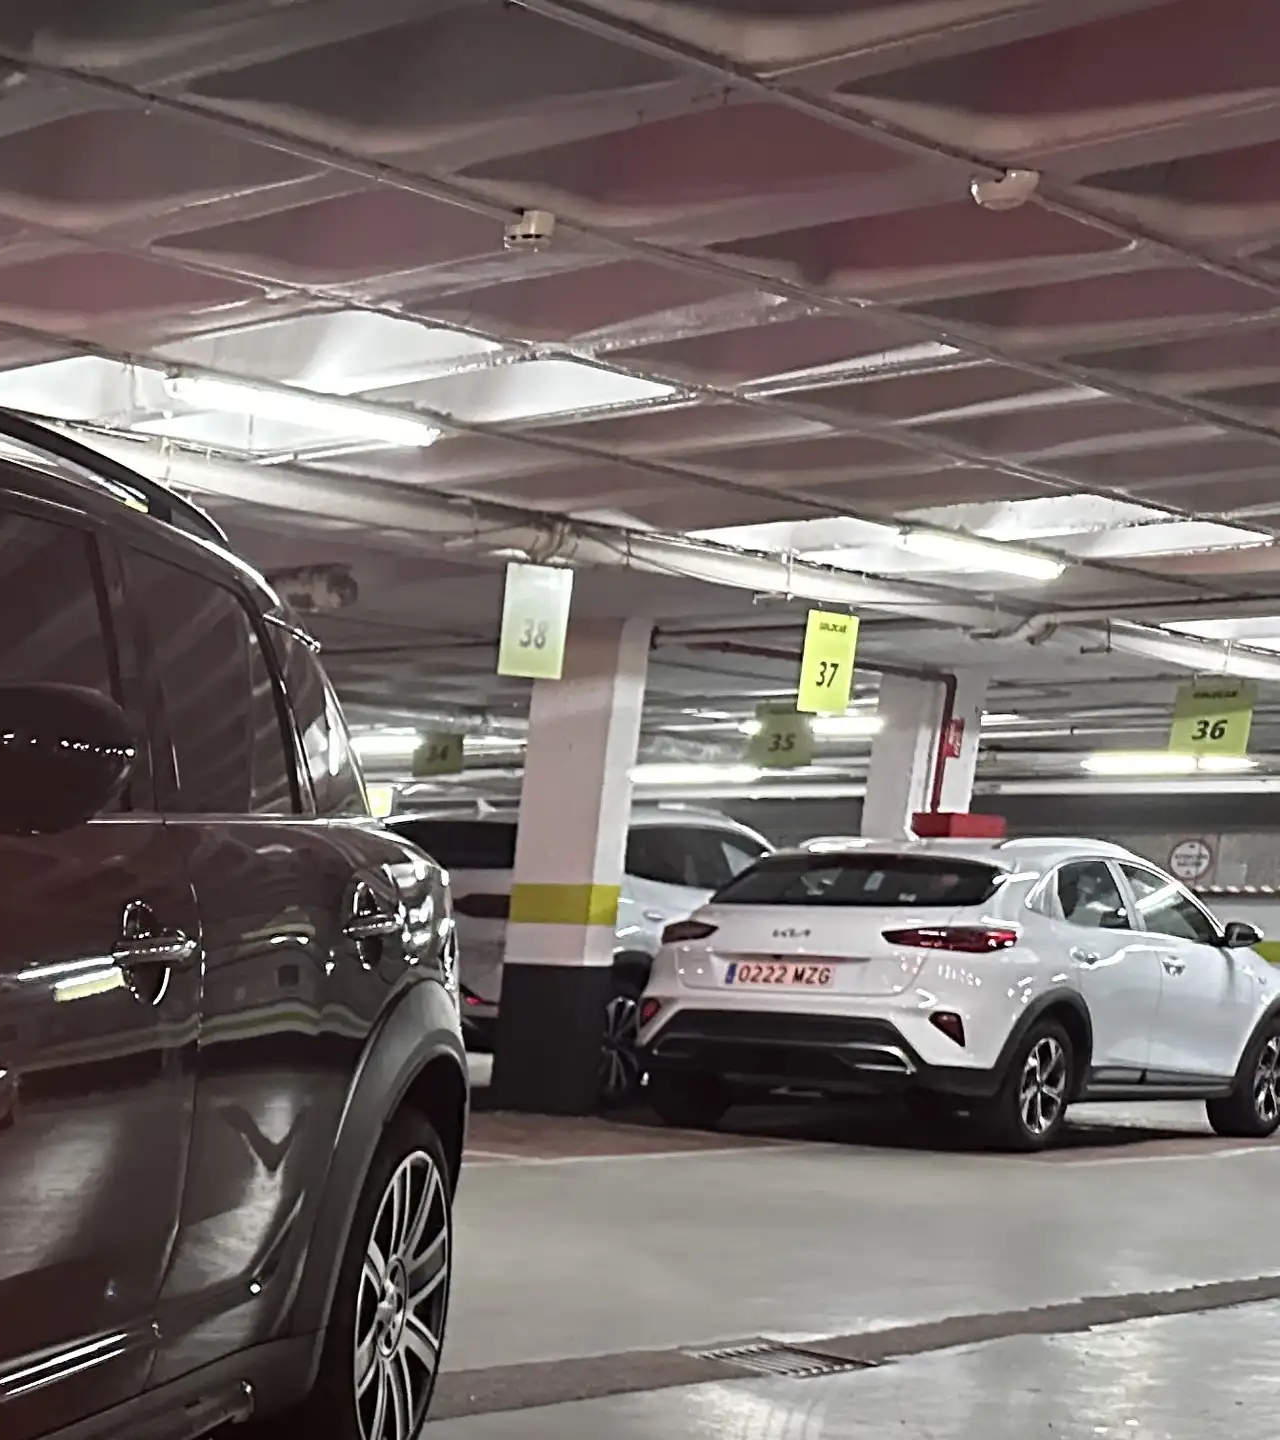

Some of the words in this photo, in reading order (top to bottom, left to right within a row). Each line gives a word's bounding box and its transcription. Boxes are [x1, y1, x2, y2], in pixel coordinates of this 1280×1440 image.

[518, 617, 549, 650] 38
[815, 661, 839, 689] 37
[1191, 719, 1228, 741] 36
[767, 732, 797, 753] 35
[738, 964, 789, 984] 0222
[793, 965, 832, 985] MZG
